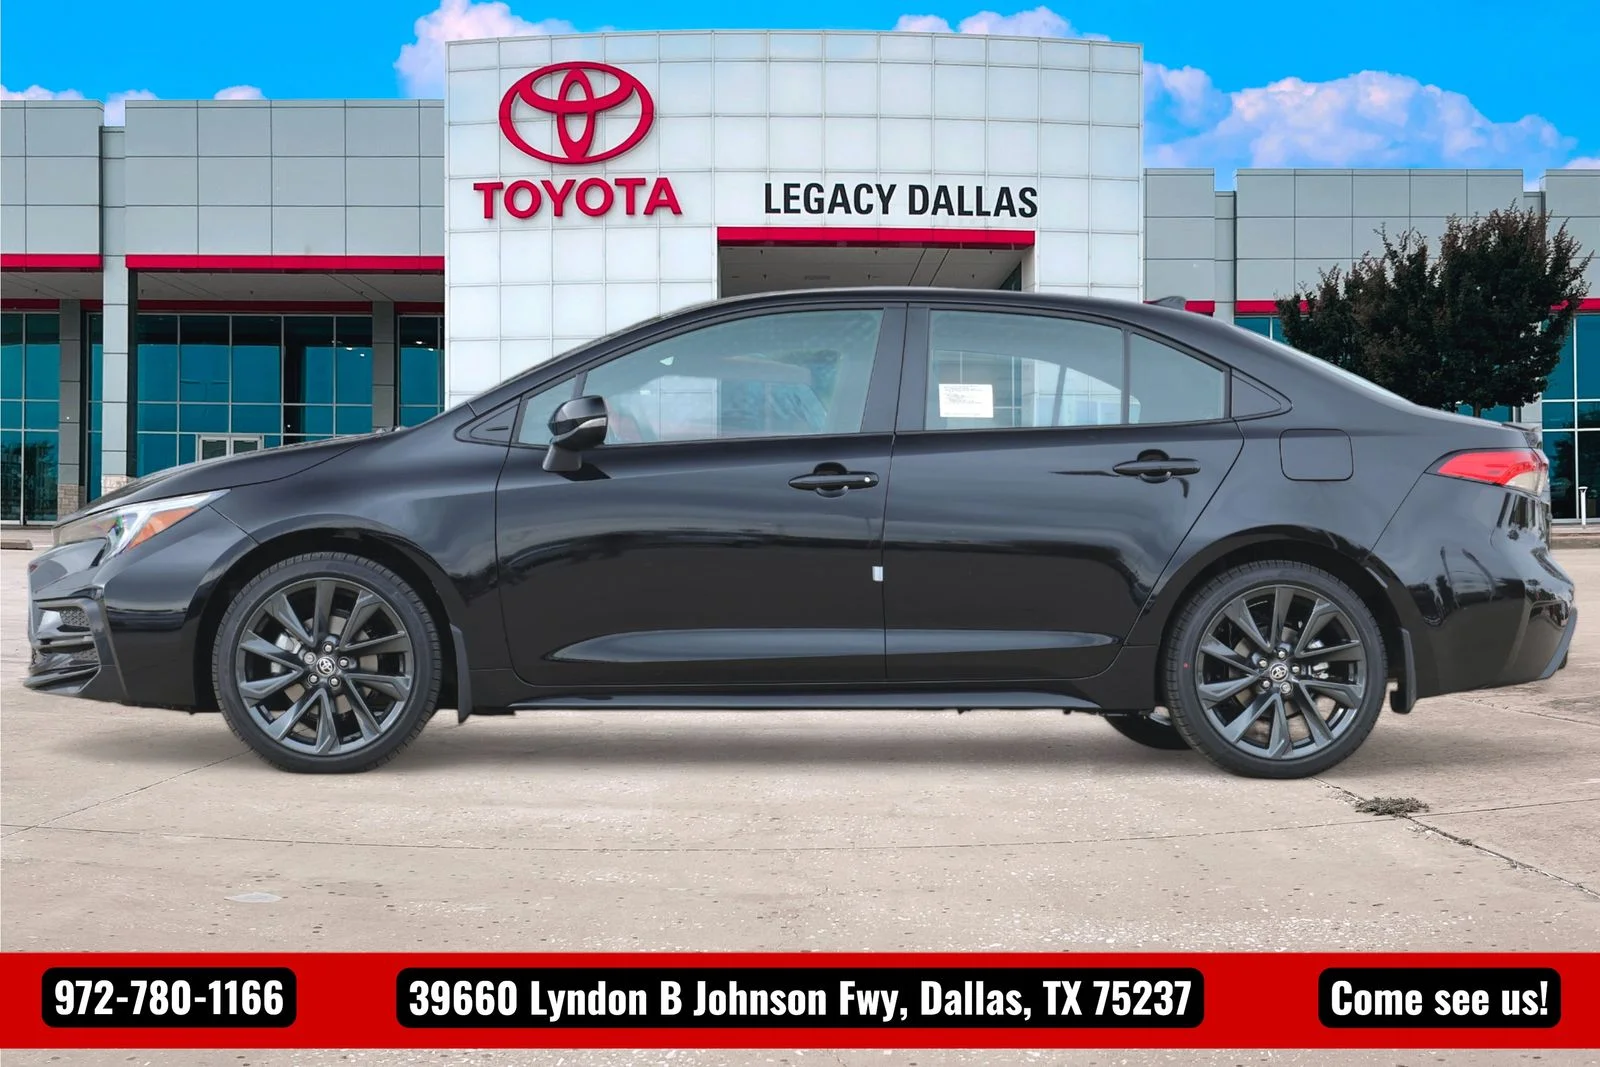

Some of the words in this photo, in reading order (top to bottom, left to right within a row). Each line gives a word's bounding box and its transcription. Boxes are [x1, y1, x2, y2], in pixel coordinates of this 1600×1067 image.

[474, 177, 681, 219] TOYOTA
[764, 182, 897, 215] LEGACY
[908, 184, 1038, 218] DALLAS
